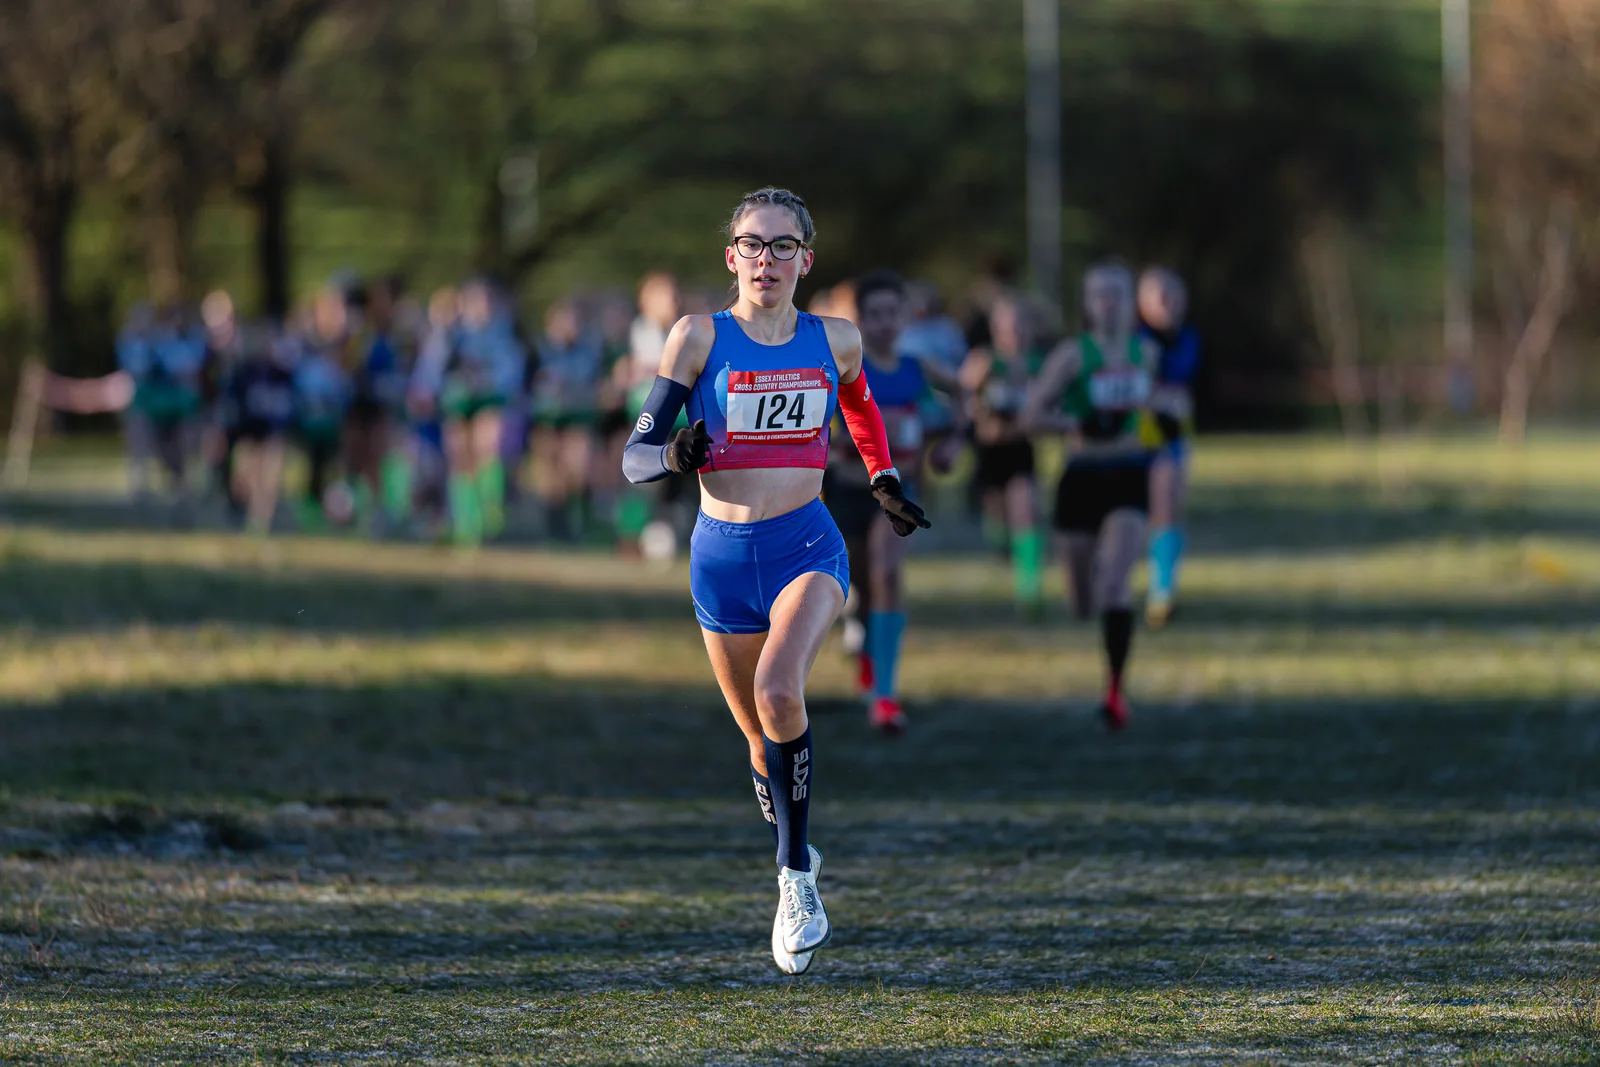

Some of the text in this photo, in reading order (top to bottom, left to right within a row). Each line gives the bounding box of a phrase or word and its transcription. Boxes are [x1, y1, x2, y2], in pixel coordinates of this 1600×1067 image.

[755, 373, 801, 383] ESSEX ATHLETICS
[753, 382, 778, 391] COUNTRY
[779, 380, 821, 388] CHAMPIONSHIPS
[755, 393, 805, 429] 124
